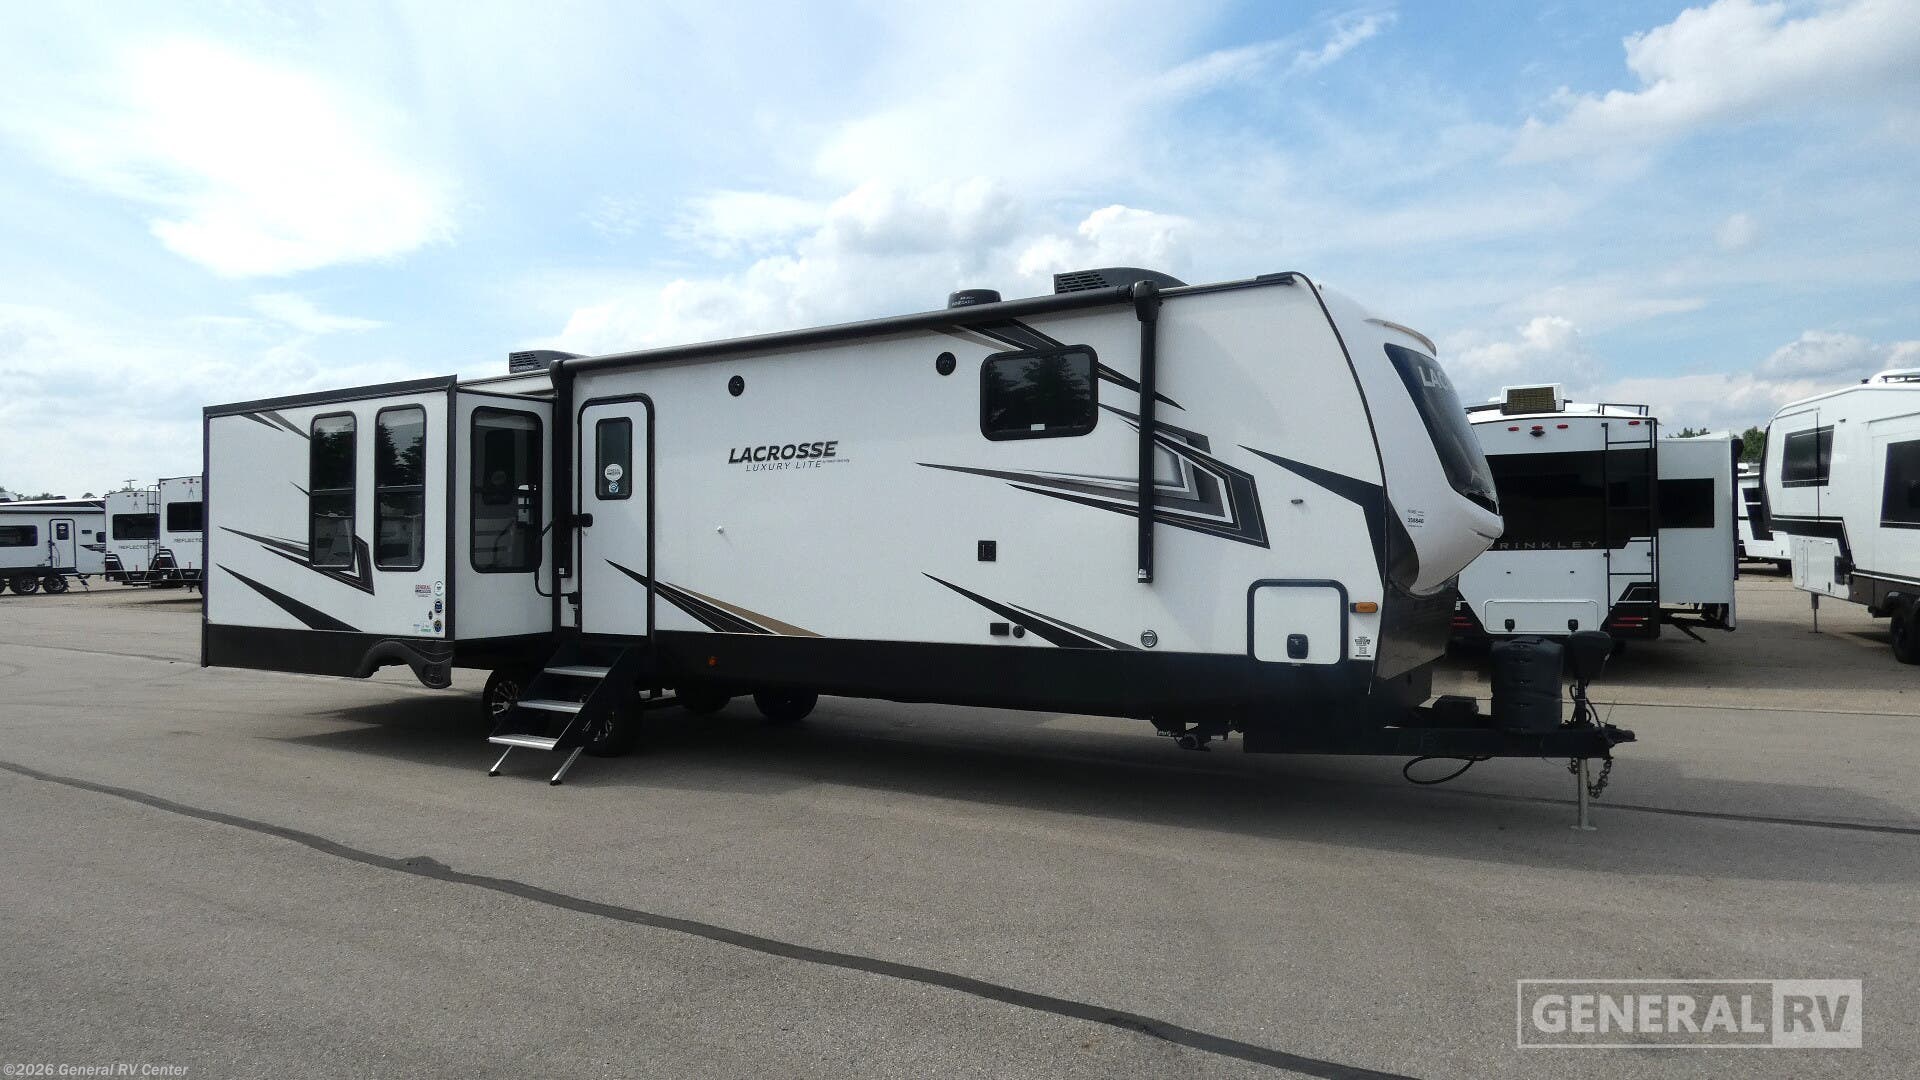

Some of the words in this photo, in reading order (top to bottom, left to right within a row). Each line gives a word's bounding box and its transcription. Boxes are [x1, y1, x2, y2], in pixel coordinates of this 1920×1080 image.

[728, 441, 839, 464] LACROSSE
[746, 462, 790, 472] LUXURY
[796, 460, 822, 469] LITE
[1491, 541, 1598, 550] RINKLEY
